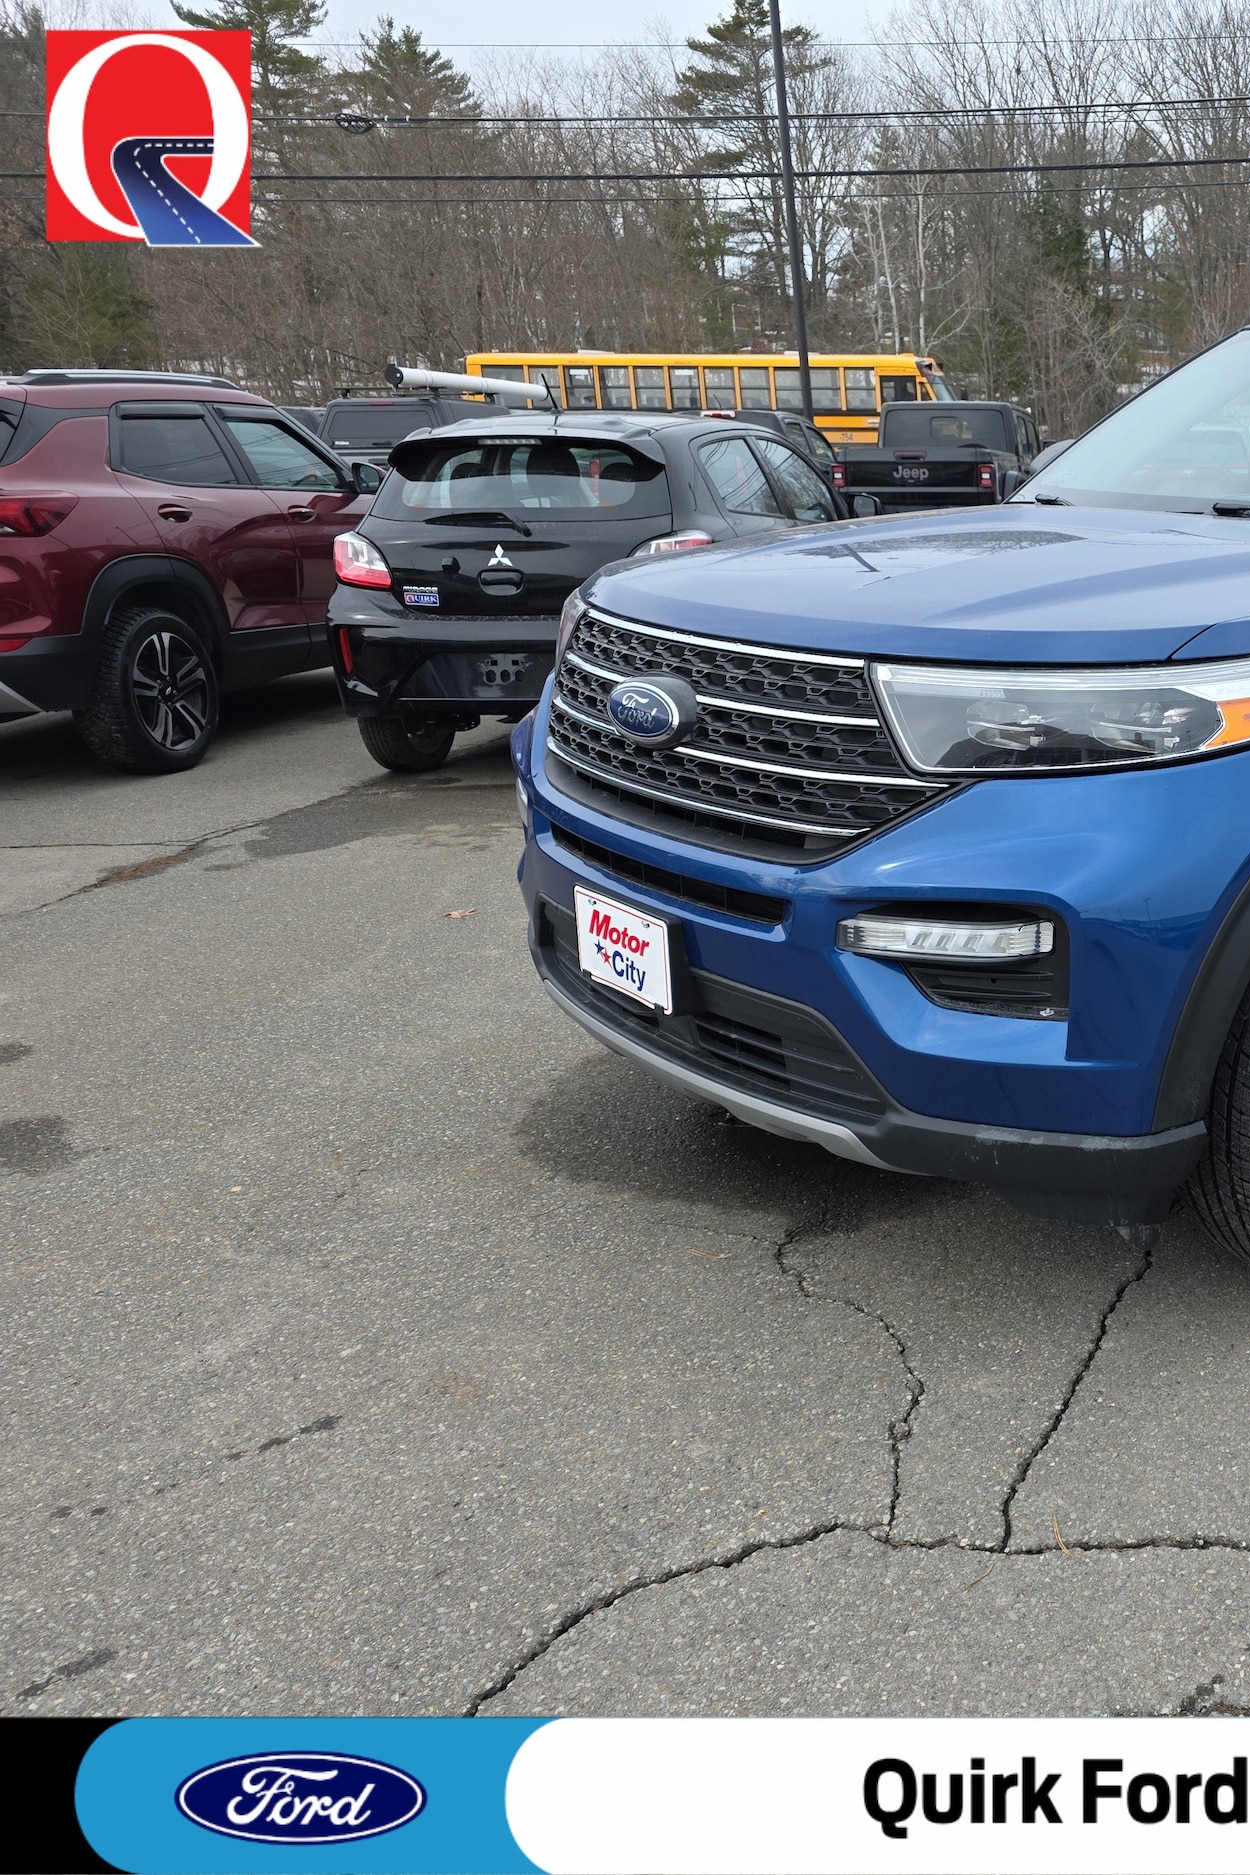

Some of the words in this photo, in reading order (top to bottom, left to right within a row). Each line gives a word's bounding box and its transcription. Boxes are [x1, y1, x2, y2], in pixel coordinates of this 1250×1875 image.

[893, 465, 929, 481] Jeep
[406, 594, 437, 602] QUIRK
[617, 692, 656, 728] Ford
[589, 908, 650, 957] Motor
[612, 950, 646, 992] City
